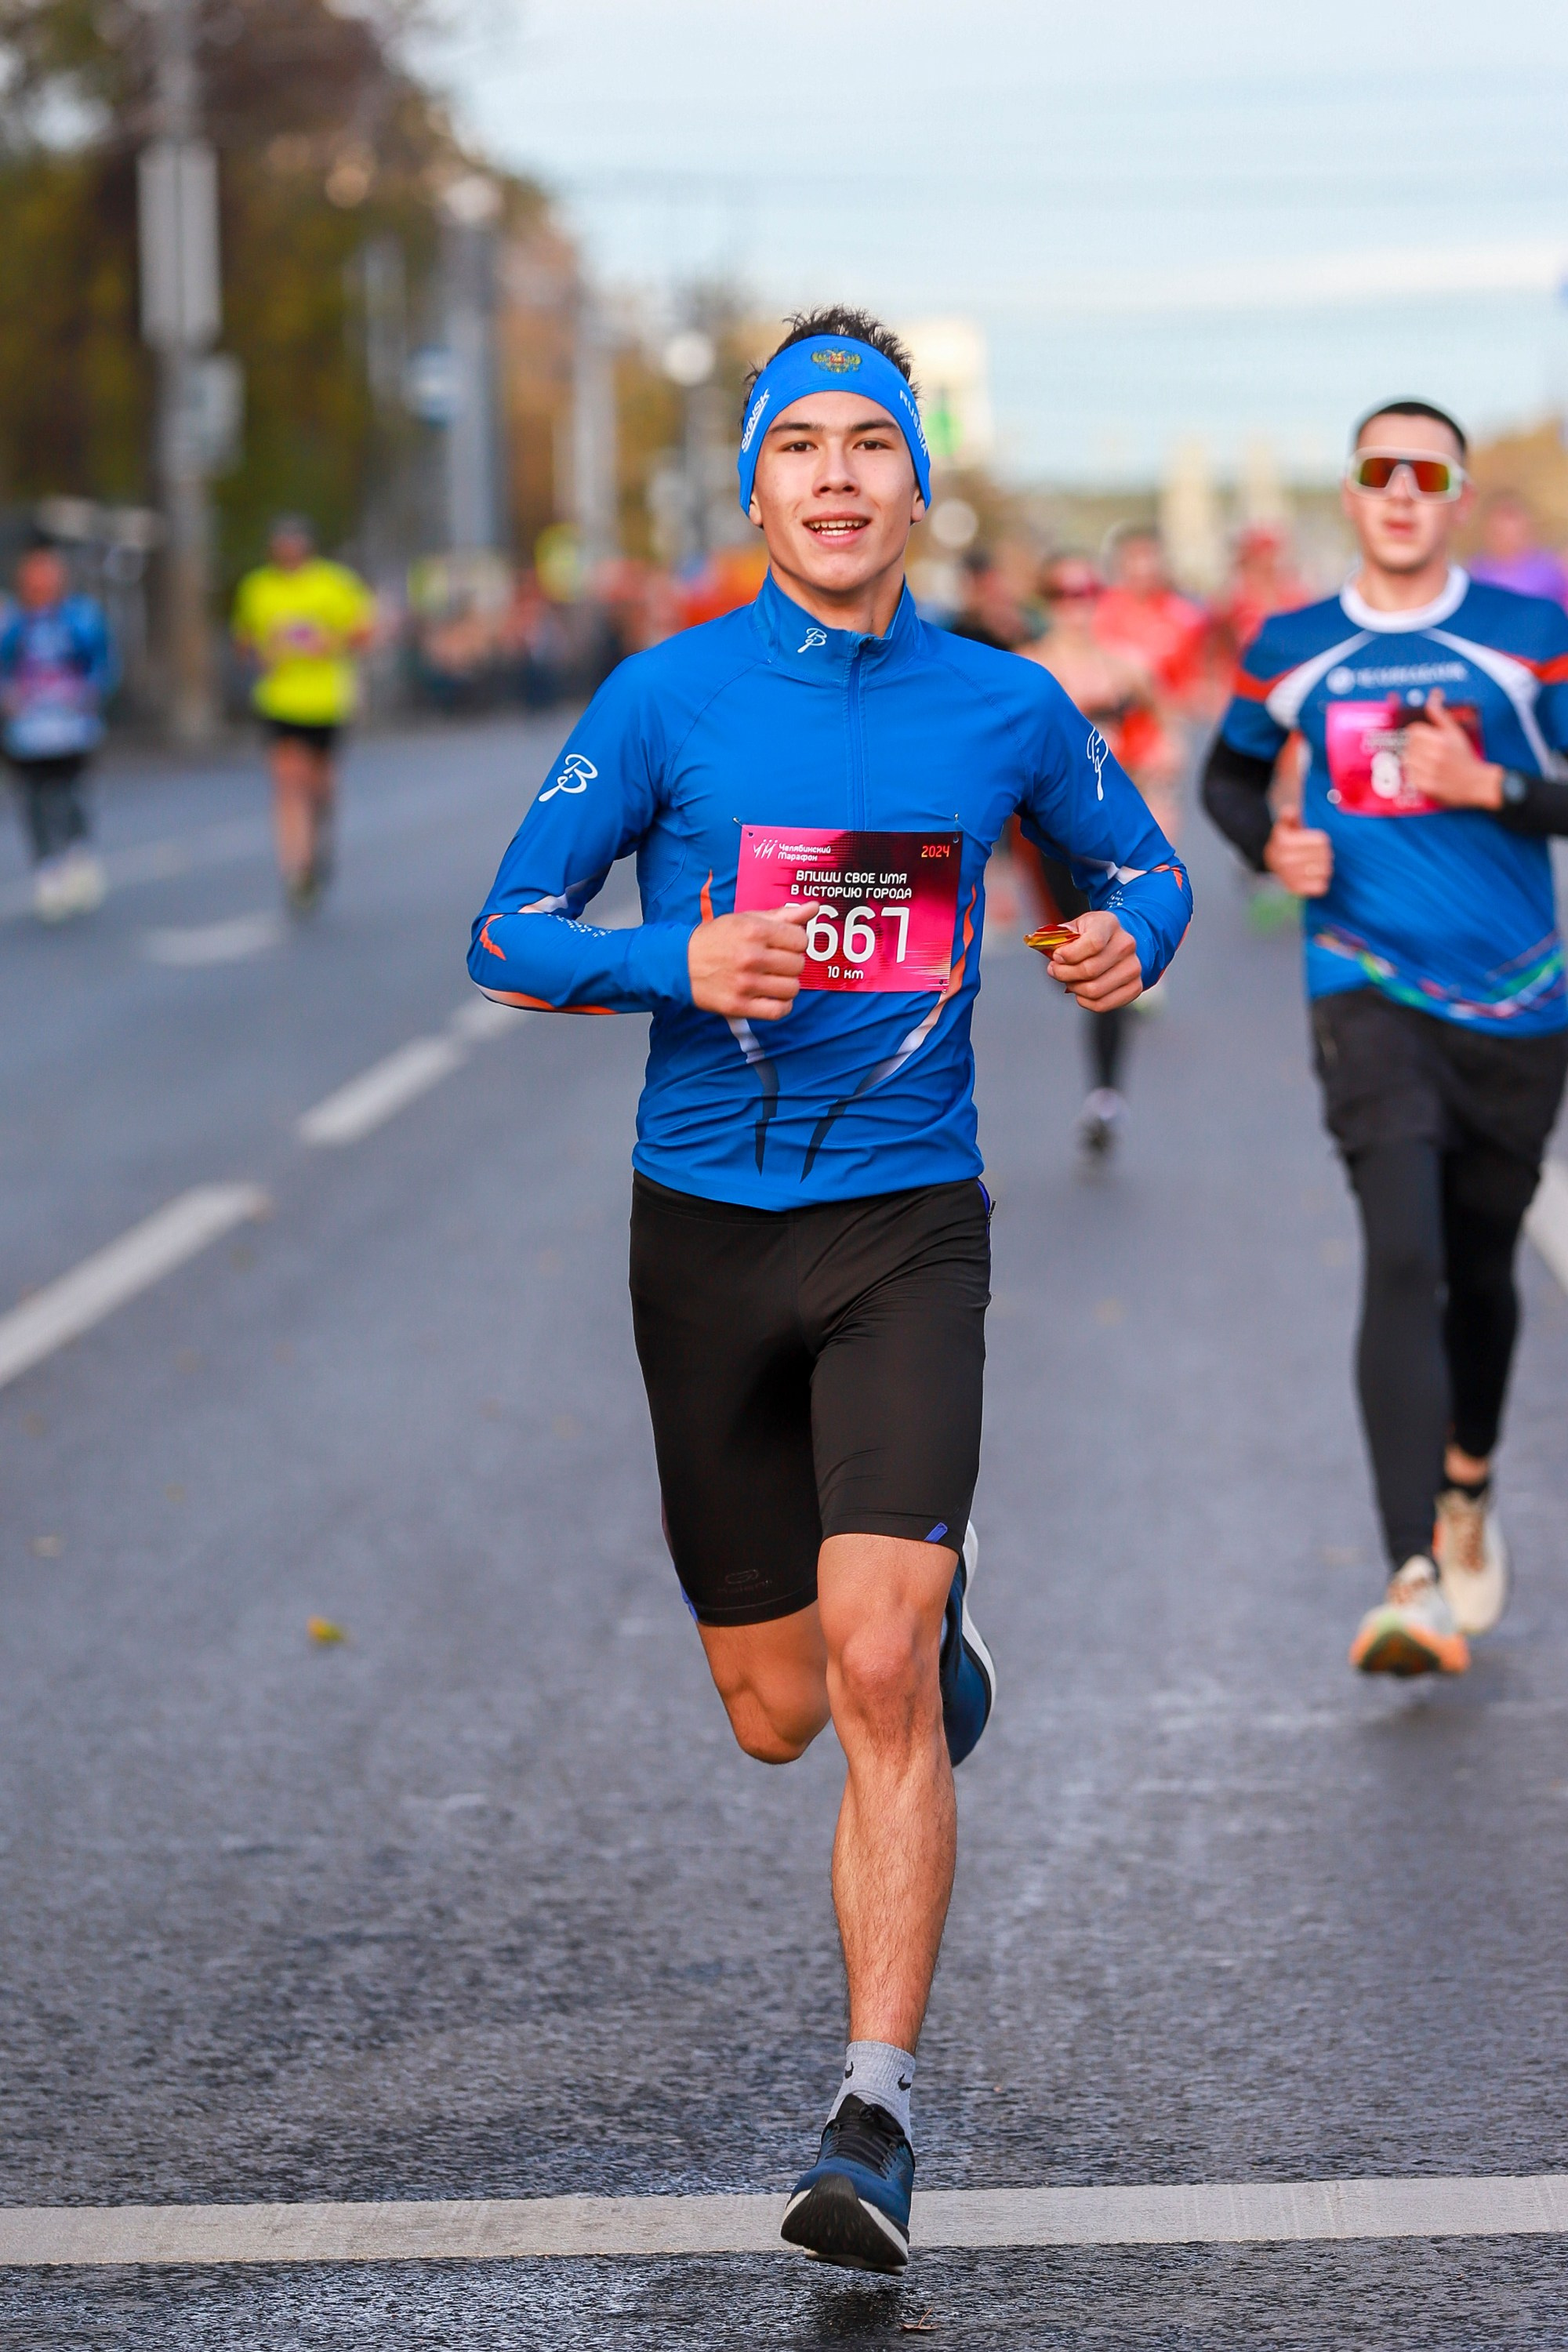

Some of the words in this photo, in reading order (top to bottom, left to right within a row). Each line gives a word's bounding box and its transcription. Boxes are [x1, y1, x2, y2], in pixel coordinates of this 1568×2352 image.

[779, 844, 831, 854] Челябинский
[921, 845, 950, 858] 2024
[777, 851, 818, 862] Марафон
[796, 869, 841, 883] ВПИШИ
[844, 872, 876, 884] СВОЕ
[880, 873, 907, 884] ИМЯ
[790, 884, 800, 895] В
[803, 885, 862, 898] ИСТОРИЮ
[866, 887, 913, 900] ГОРОДА
[784, 902, 910, 964] 667
[827, 965, 840, 978] 10
